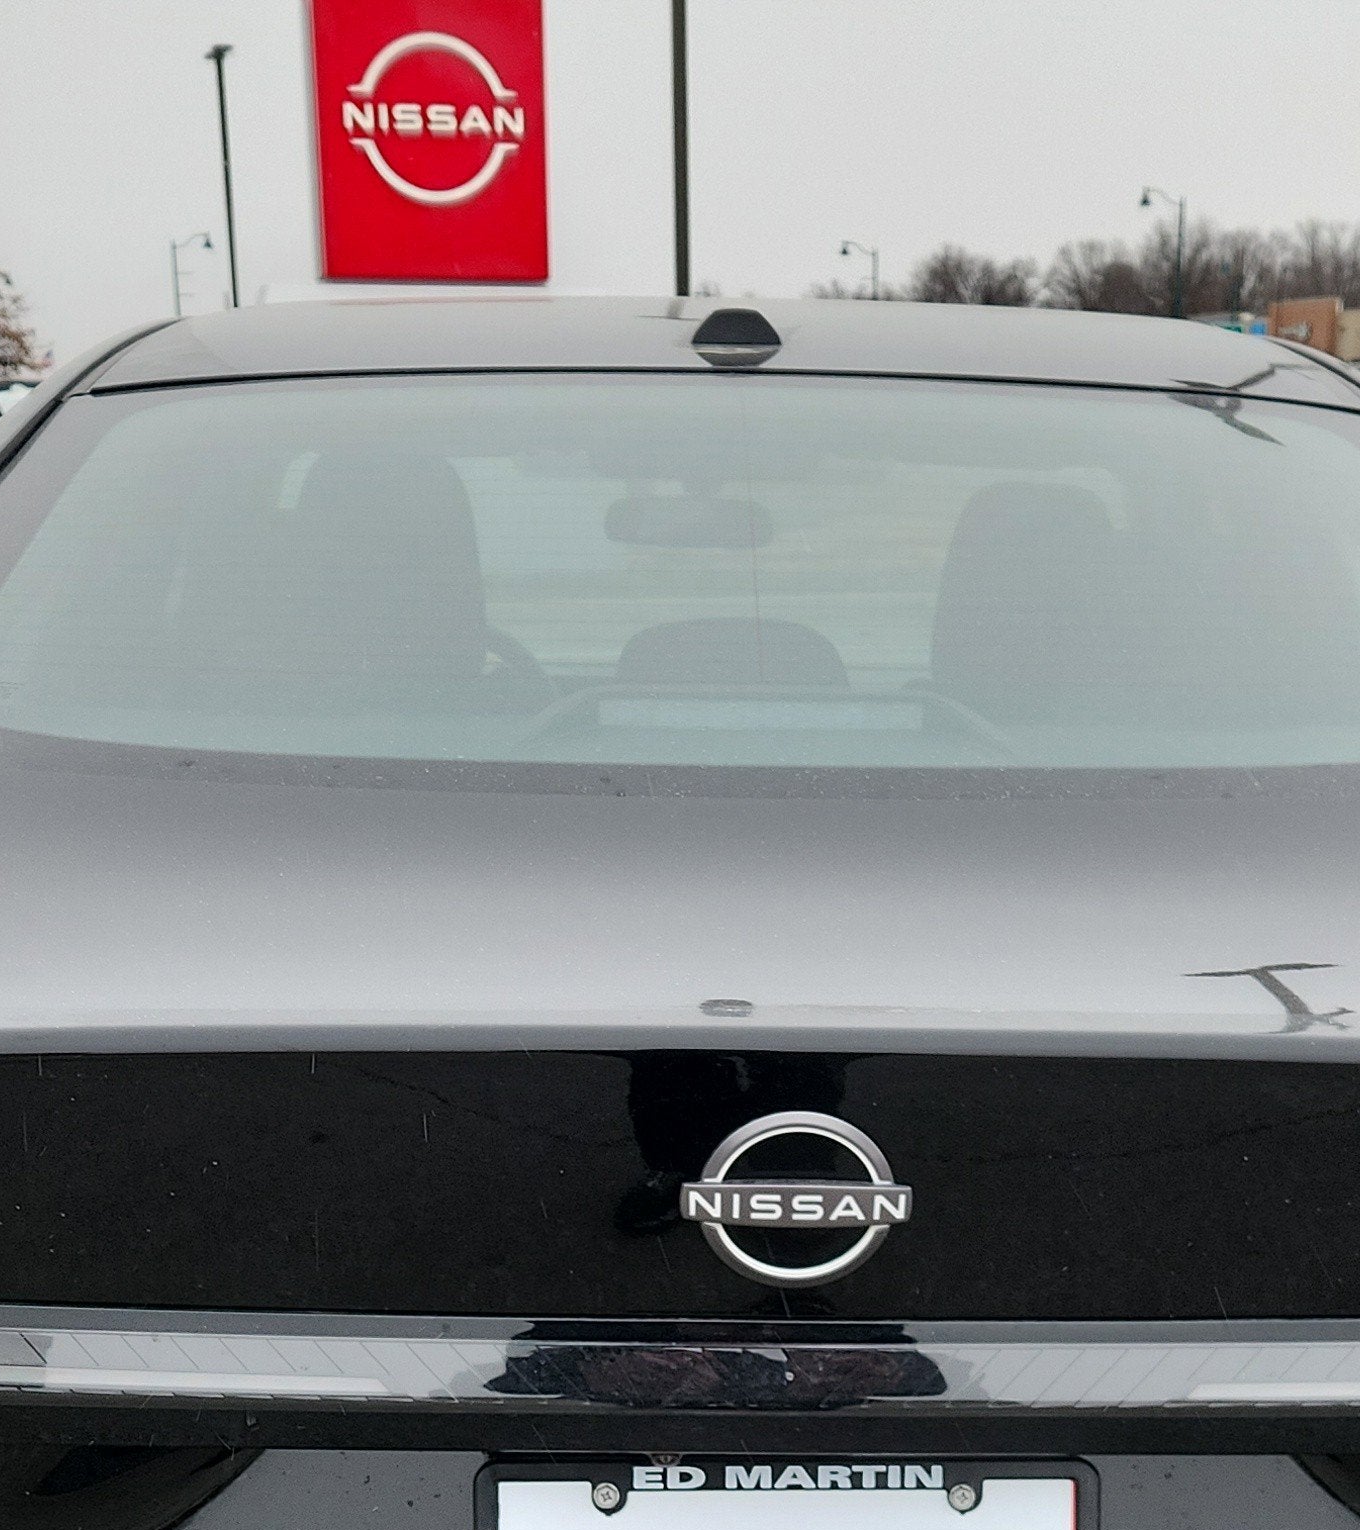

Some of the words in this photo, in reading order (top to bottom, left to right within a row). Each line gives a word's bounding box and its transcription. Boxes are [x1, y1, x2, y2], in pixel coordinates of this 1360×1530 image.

[342, 101, 525, 137] NISSAN
[688, 1190, 907, 1221] NISSAN
[632, 1465, 706, 1490] ED
[725, 1464, 943, 1490] MARTIN
